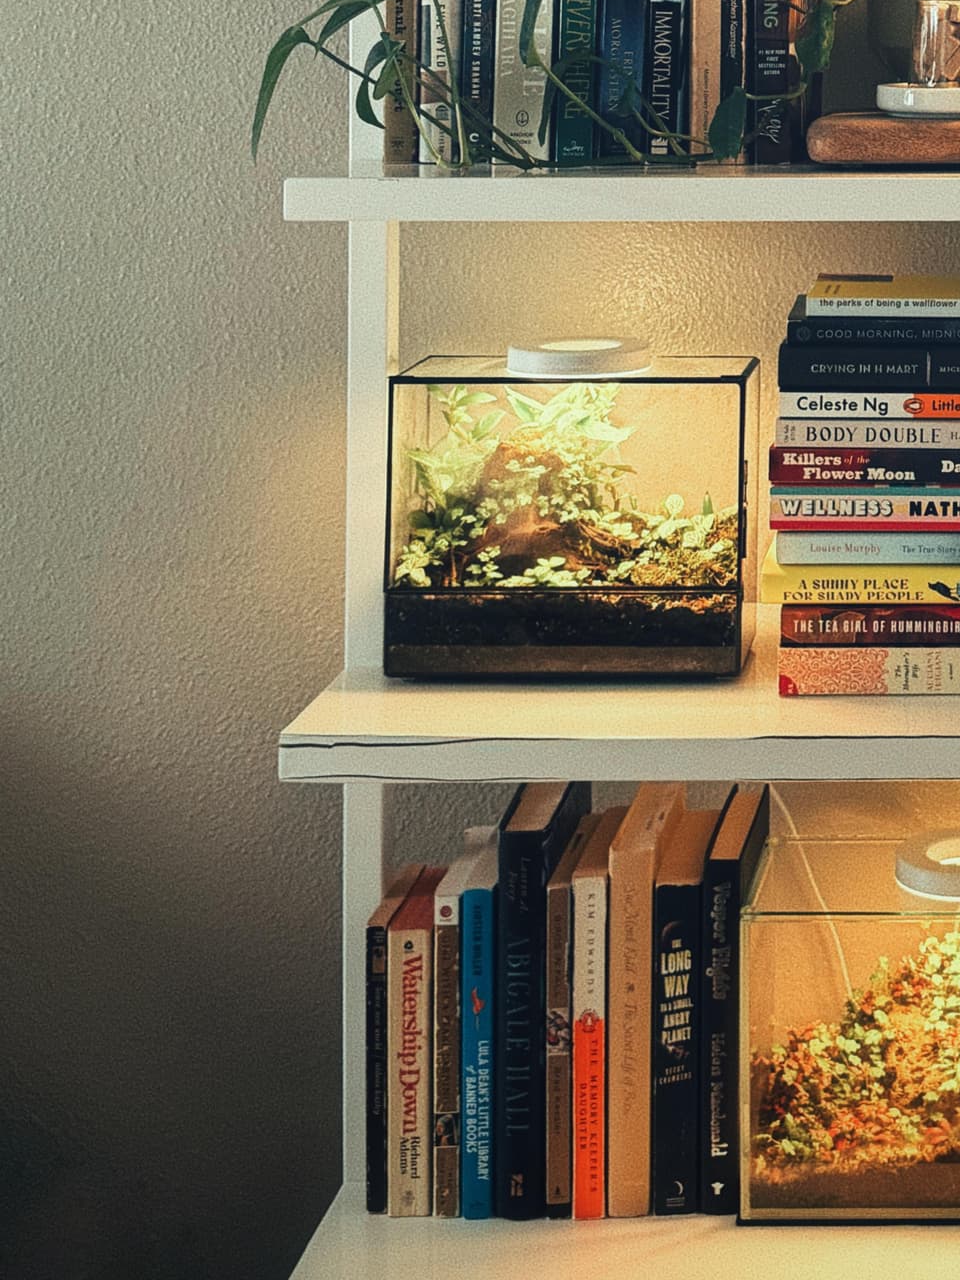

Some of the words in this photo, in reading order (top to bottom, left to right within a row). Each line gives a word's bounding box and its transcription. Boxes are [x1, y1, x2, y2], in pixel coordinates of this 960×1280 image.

[651, 11, 673, 121] IMMORTALITY
[810, 363, 857, 375] CRYING
[859, 363, 872, 375] IN
[874, 364, 883, 375] H
[886, 363, 919, 375] MART
[796, 395, 860, 413] Celeste
[863, 396, 890, 417] Ng
[805, 426, 858, 443] BODY
[864, 426, 942, 444] DOUBLE
[802, 467, 864, 481] Flower
[866, 467, 916, 481] Moon
[779, 498, 894, 518] WELLNESS
[783, 590, 814, 602] FOR
[817, 590, 864, 602] SHADY
[867, 590, 925, 602] PEOPLE
[798, 578, 808, 590] A
[812, 578, 860, 590] SUNNY
[863, 578, 910, 590] PLACE
[793, 619, 814, 633] THE
[818, 619, 839, 634] TEA
[843, 619, 868, 634] GIRL
[872, 619, 887, 634] OF
[587, 893, 596, 920] KIM
[587, 929, 596, 995] EDWARDS
[661, 949, 692, 976] LONG
[663, 973, 690, 999] WAY
[397, 954, 423, 1065] Watership
[478, 1040, 490, 1065] LULA
[589, 1039, 599, 1066] THE
[477, 1068, 490, 1104] DEAN'S
[398, 1068, 421, 1135] Down
[589, 1075, 599, 1127] MEMORY
[477, 1105, 489, 1137] LITTLE
[579, 1082, 588, 1151] DAUGHTER
[399, 1136, 409, 1175] Adams
[410, 1136, 421, 1180] Richard
[477, 1137, 489, 1181] LIBRARY
[589, 1132, 598, 1193] KEEPER'S
